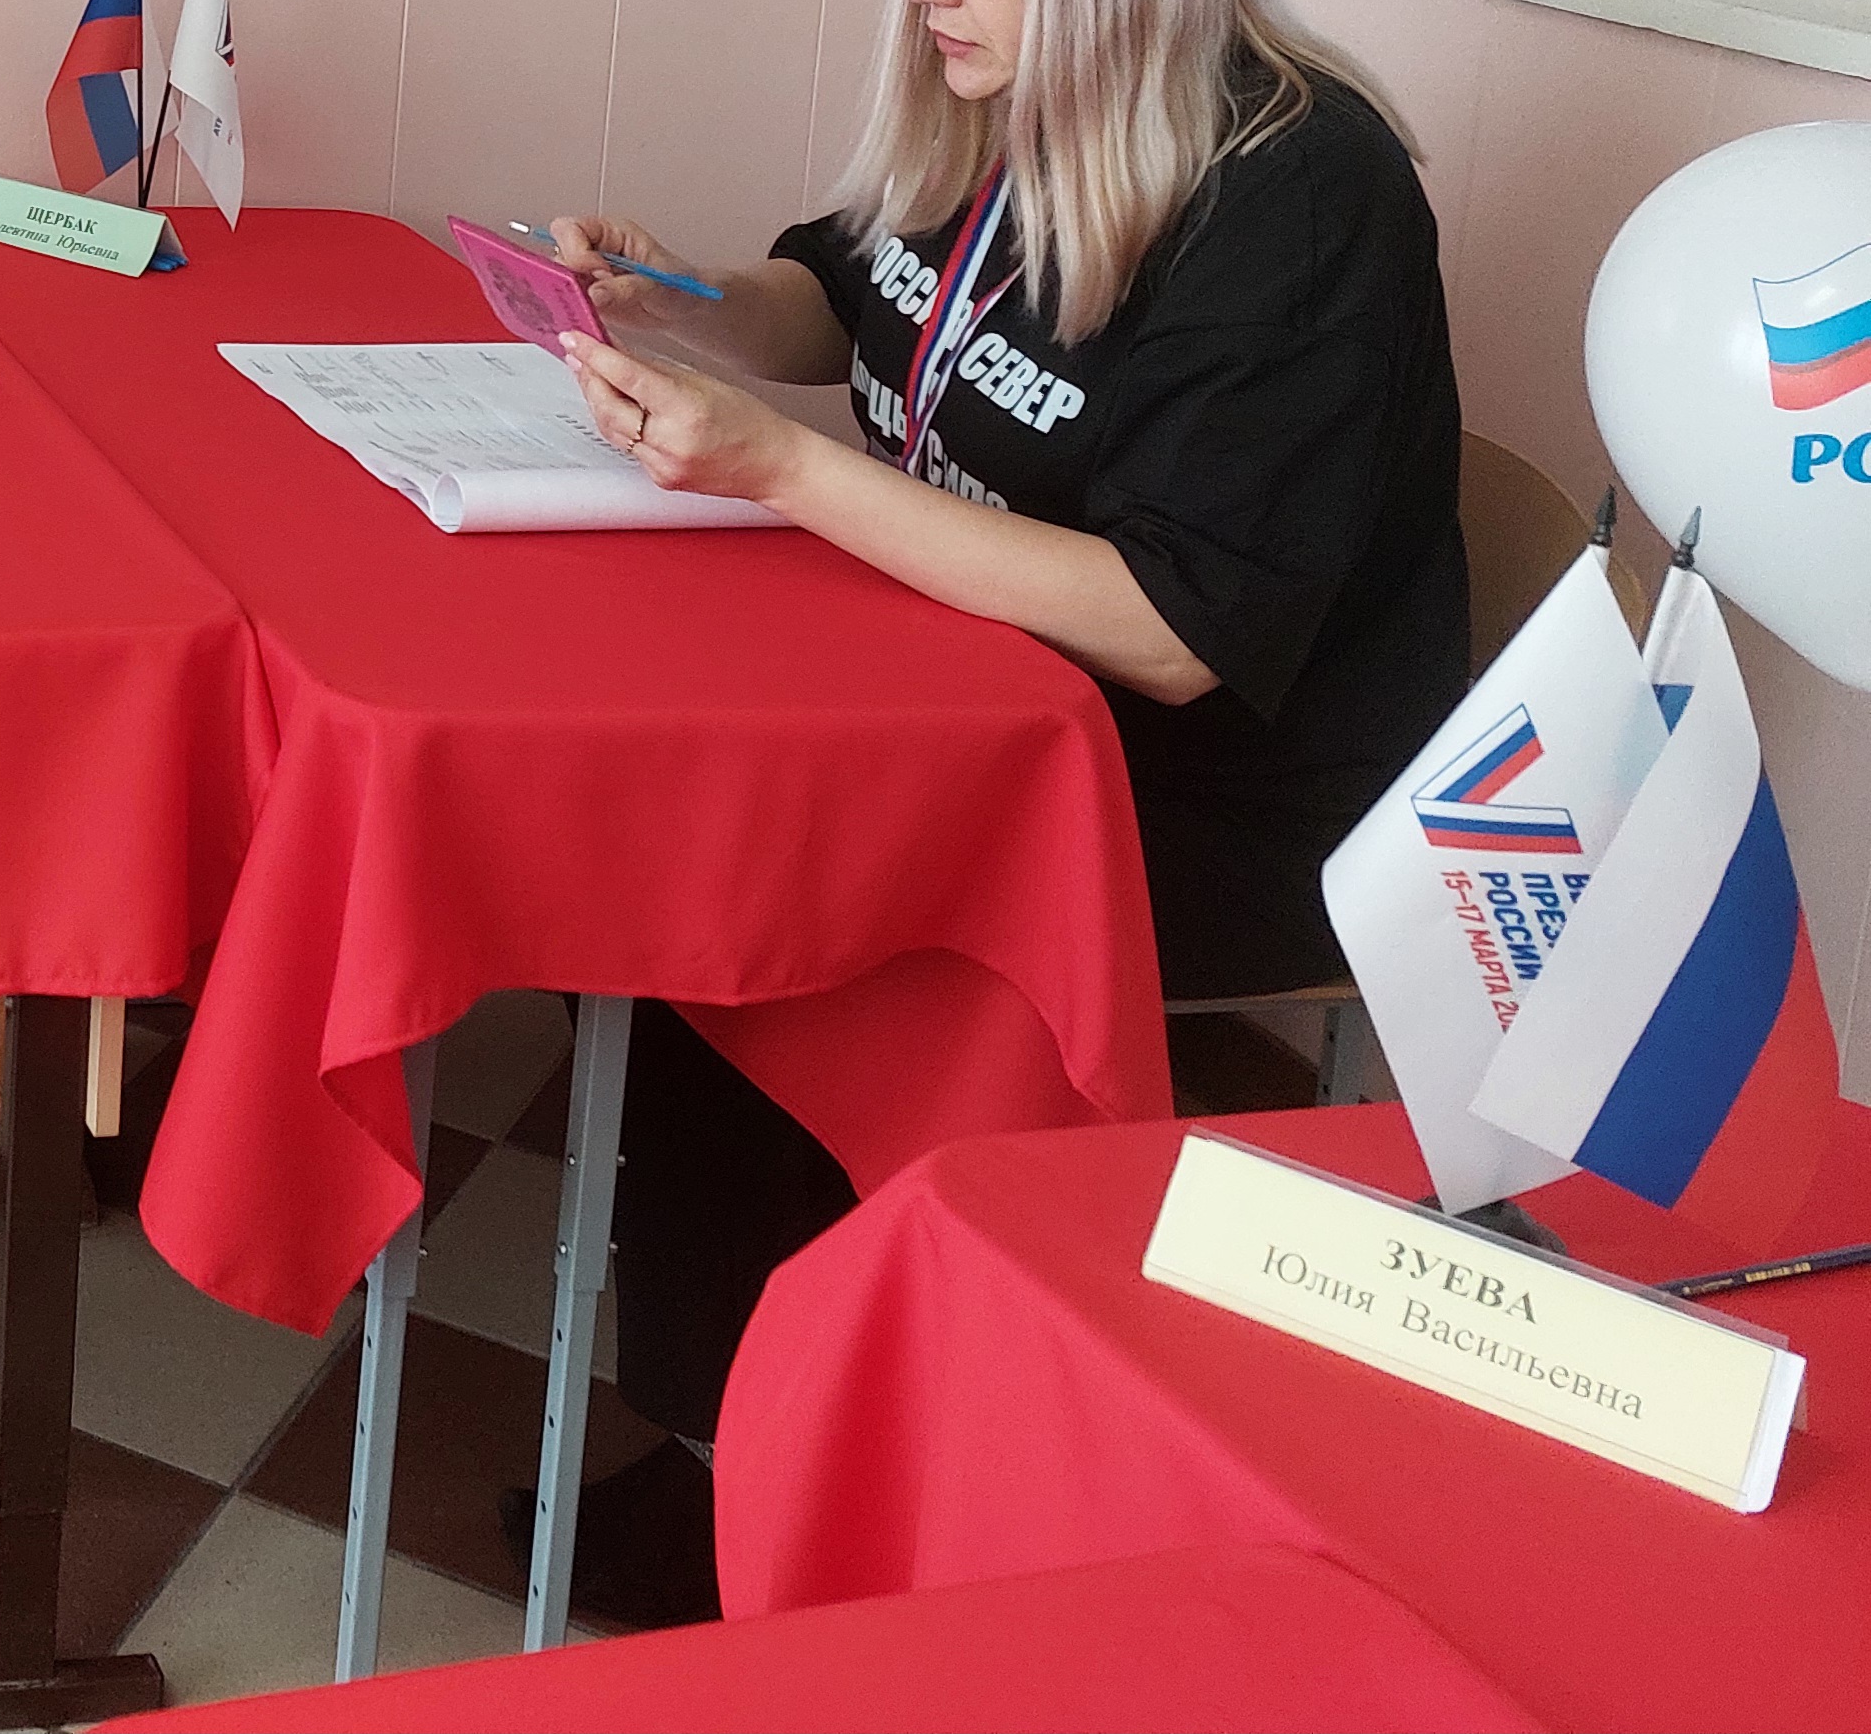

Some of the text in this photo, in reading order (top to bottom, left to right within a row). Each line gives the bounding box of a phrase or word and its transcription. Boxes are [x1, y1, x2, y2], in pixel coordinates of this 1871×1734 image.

[26, 206, 99, 235] ЩЕРБАК
[55, 234, 120, 261] Юрьевна
[958, 333, 1086, 434] СЕВЕР
[1464, 928, 1514, 995] МАРТА
[1379, 1238, 1537, 1326] ЗУЕВА
[1262, 1243, 1643, 1420] Юлия Васильевна
